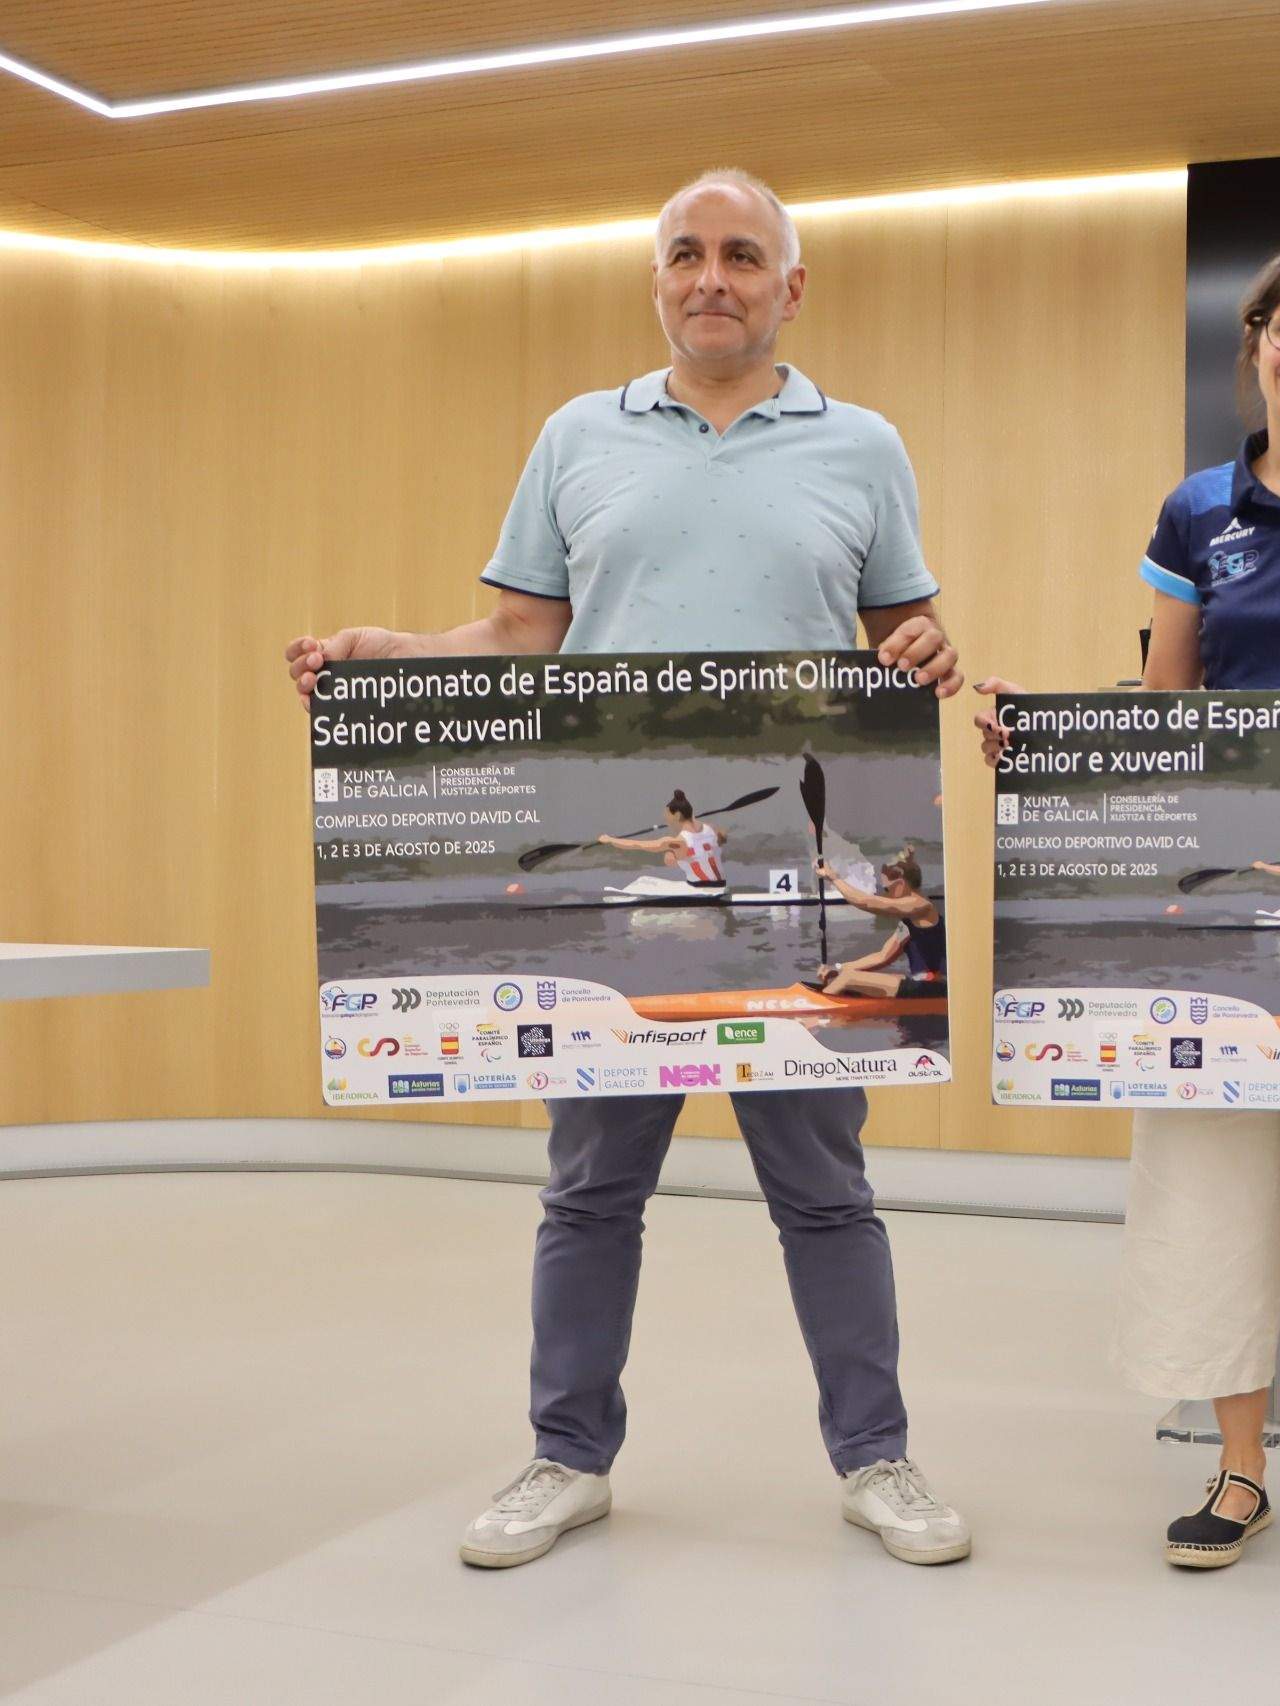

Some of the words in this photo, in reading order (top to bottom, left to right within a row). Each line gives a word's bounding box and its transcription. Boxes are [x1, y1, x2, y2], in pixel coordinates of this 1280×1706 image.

[1209, 527, 1255, 547] MERCURY
[313, 669, 491, 707] Campionato
[500, 664, 534, 696] de
[544, 663, 648, 703] España
[657, 660, 691, 692] de
[700, 661, 788, 699] Sprint
[998, 703, 1159, 739] Campionato
[1167, 700, 1199, 730] de
[314, 713, 407, 746] Sénior
[415, 720, 430, 743] e
[439, 708, 541, 743] xuvenil
[999, 744, 1081, 773] Sénior
[1089, 751, 1103, 771] e
[1110, 742, 1203, 771] xuvenil
[344, 770, 395, 783] XUNTA
[440, 766, 501, 776] CONSELLERÍA
[504, 767, 515, 775] DE
[440, 777, 501, 786] PRESIDENCIA,
[344, 787, 362, 798] DE
[368, 784, 428, 797] GALICIA
[441, 787, 479, 795] XUSTIZA
[489, 785, 536, 794] DEPORTES
[1024, 796, 1069, 808] XUNTA
[1110, 794, 1165, 803] CONSELLERÍA
[1110, 804, 1165, 813] PRESIDENCIA,
[316, 814, 387, 828] COMPLEXO
[392, 812, 465, 827] DEPORTIVO
[471, 811, 511, 824] DAVID
[515, 810, 540, 823] CAL
[1023, 811, 1039, 821] DE
[1044, 810, 1099, 821] GALICIA
[1154, 813, 1197, 821] DEPORTES
[997, 837, 1061, 849] COMPLEXO
[1065, 837, 1132, 848] DEPORTIVO
[1136, 836, 1173, 848] DAVID
[1177, 836, 1199, 848] CAL
[317, 846, 326, 860] 1,
[331, 846, 338, 858] 2
[343, 845, 349, 857] E
[353, 845, 360, 857] 3
[366, 844, 382, 856] DE
[385, 842, 440, 856] AGOSTO
[444, 842, 461, 855] DE
[465, 841, 495, 854] 2025
[998, 865, 1006, 877] 1,
[1010, 865, 1016, 875] 2
[1020, 865, 1026, 875] E
[1029, 864, 1035, 875] 3
[1040, 864, 1054, 875] DE
[1058, 863, 1108, 876] AGOSTO
[1111, 864, 1126, 875] DE
[1130, 864, 1158, 875] 2025
[777, 874, 792, 892] 4
[426, 987, 480, 1000] Deputación
[561, 988, 591, 996] Concello
[331, 994, 378, 1012] FGP
[426, 998, 480, 1009] Pontevedra
[571, 994, 611, 1003] Pontevedra
[1088, 1009, 1138, 1018] Pontevedra
[629, 1028, 707, 1045] infisport
[734, 1029, 758, 1037] ence
[604, 1067, 648, 1078] DEPORTE
[784, 1056, 897, 1078] DingoNatura
[474, 1072, 517, 1083] LOTERÍAS
[411, 1080, 440, 1088] Asturias
[604, 1079, 645, 1089] GALEGO
[1127, 1080, 1167, 1090] LOTERÍAS
[332, 1092, 378, 1100] IBERDROLA
